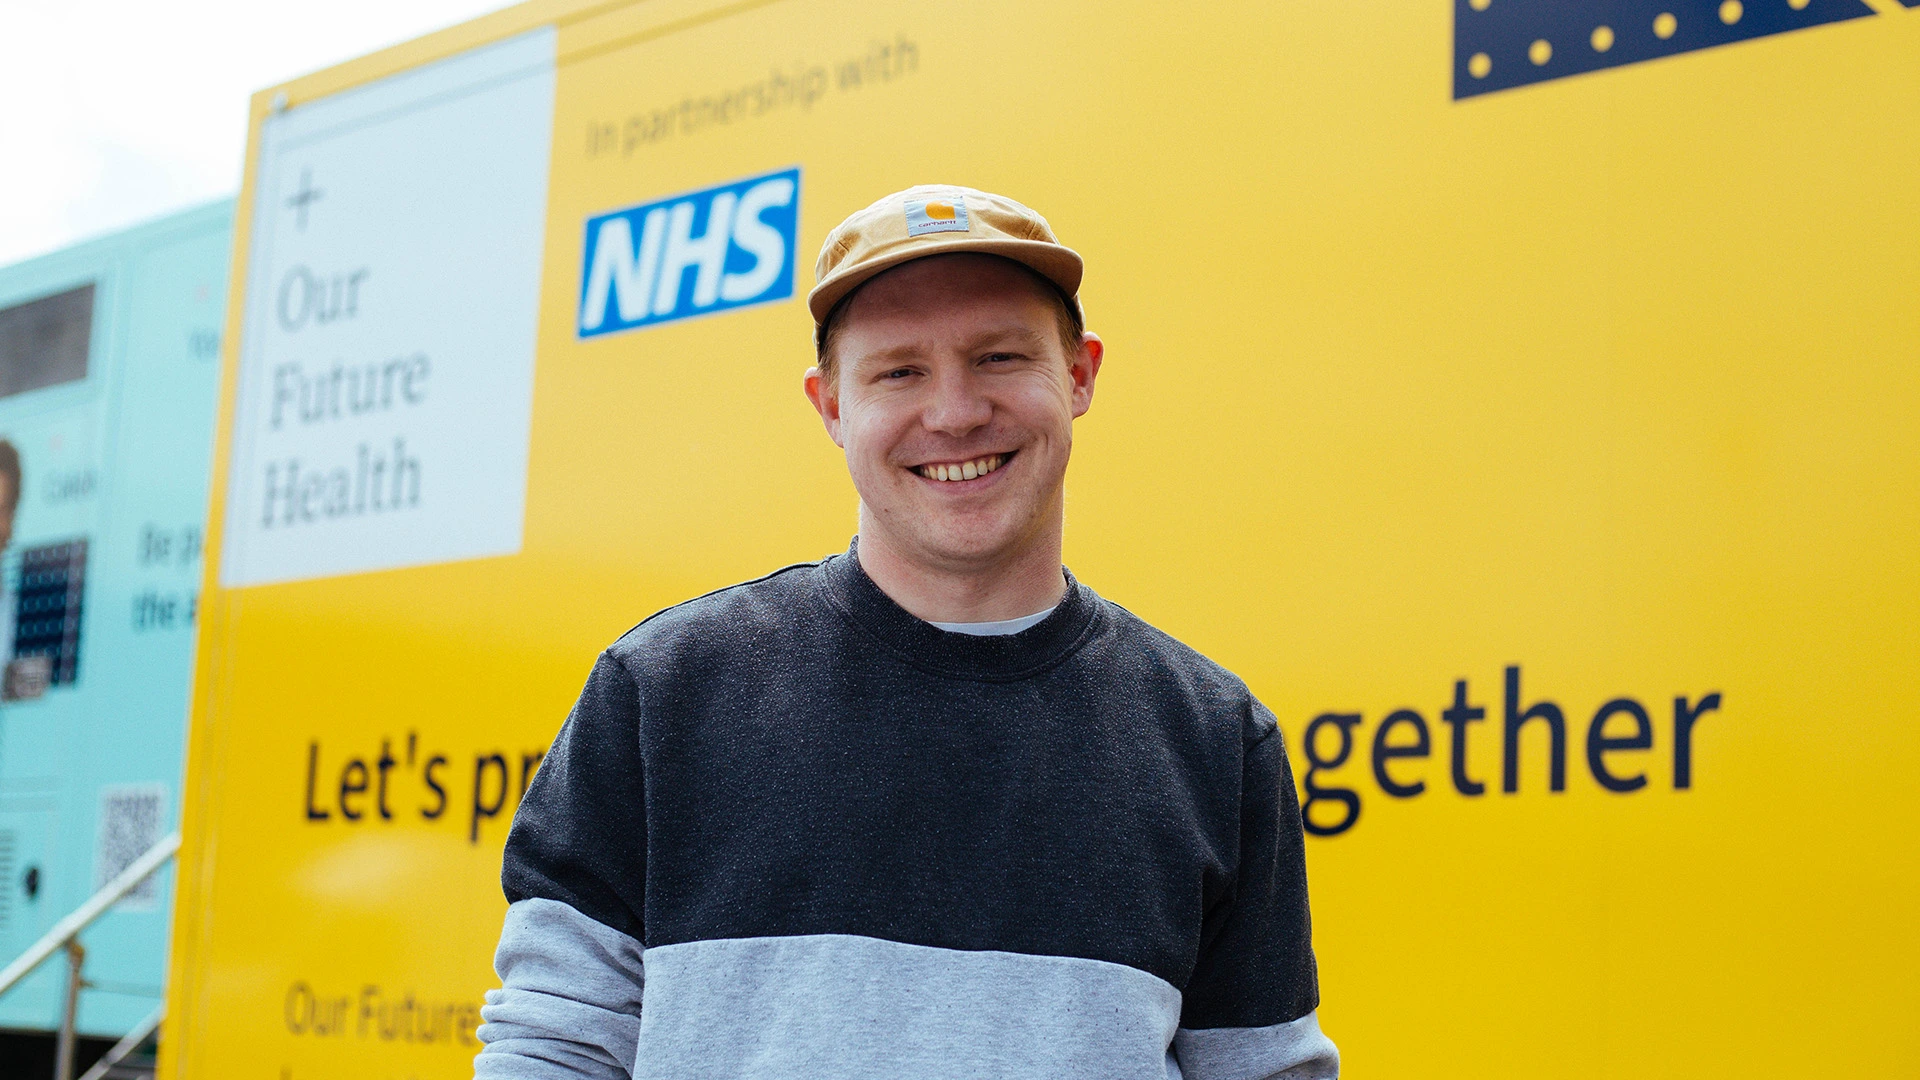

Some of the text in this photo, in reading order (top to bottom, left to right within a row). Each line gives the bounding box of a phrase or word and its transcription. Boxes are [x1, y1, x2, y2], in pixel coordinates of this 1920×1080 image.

[583, 33, 919, 160] In partnership with
[584, 181, 795, 330] NHS
[918, 220, 957, 228] carhartt
[276, 263, 370, 333] Our
[269, 352, 431, 430] Future
[261, 437, 421, 528] Health
[305, 731, 448, 822] Let's
[1301, 665, 1722, 836] gether
[284, 979, 480, 1046] Our Future
